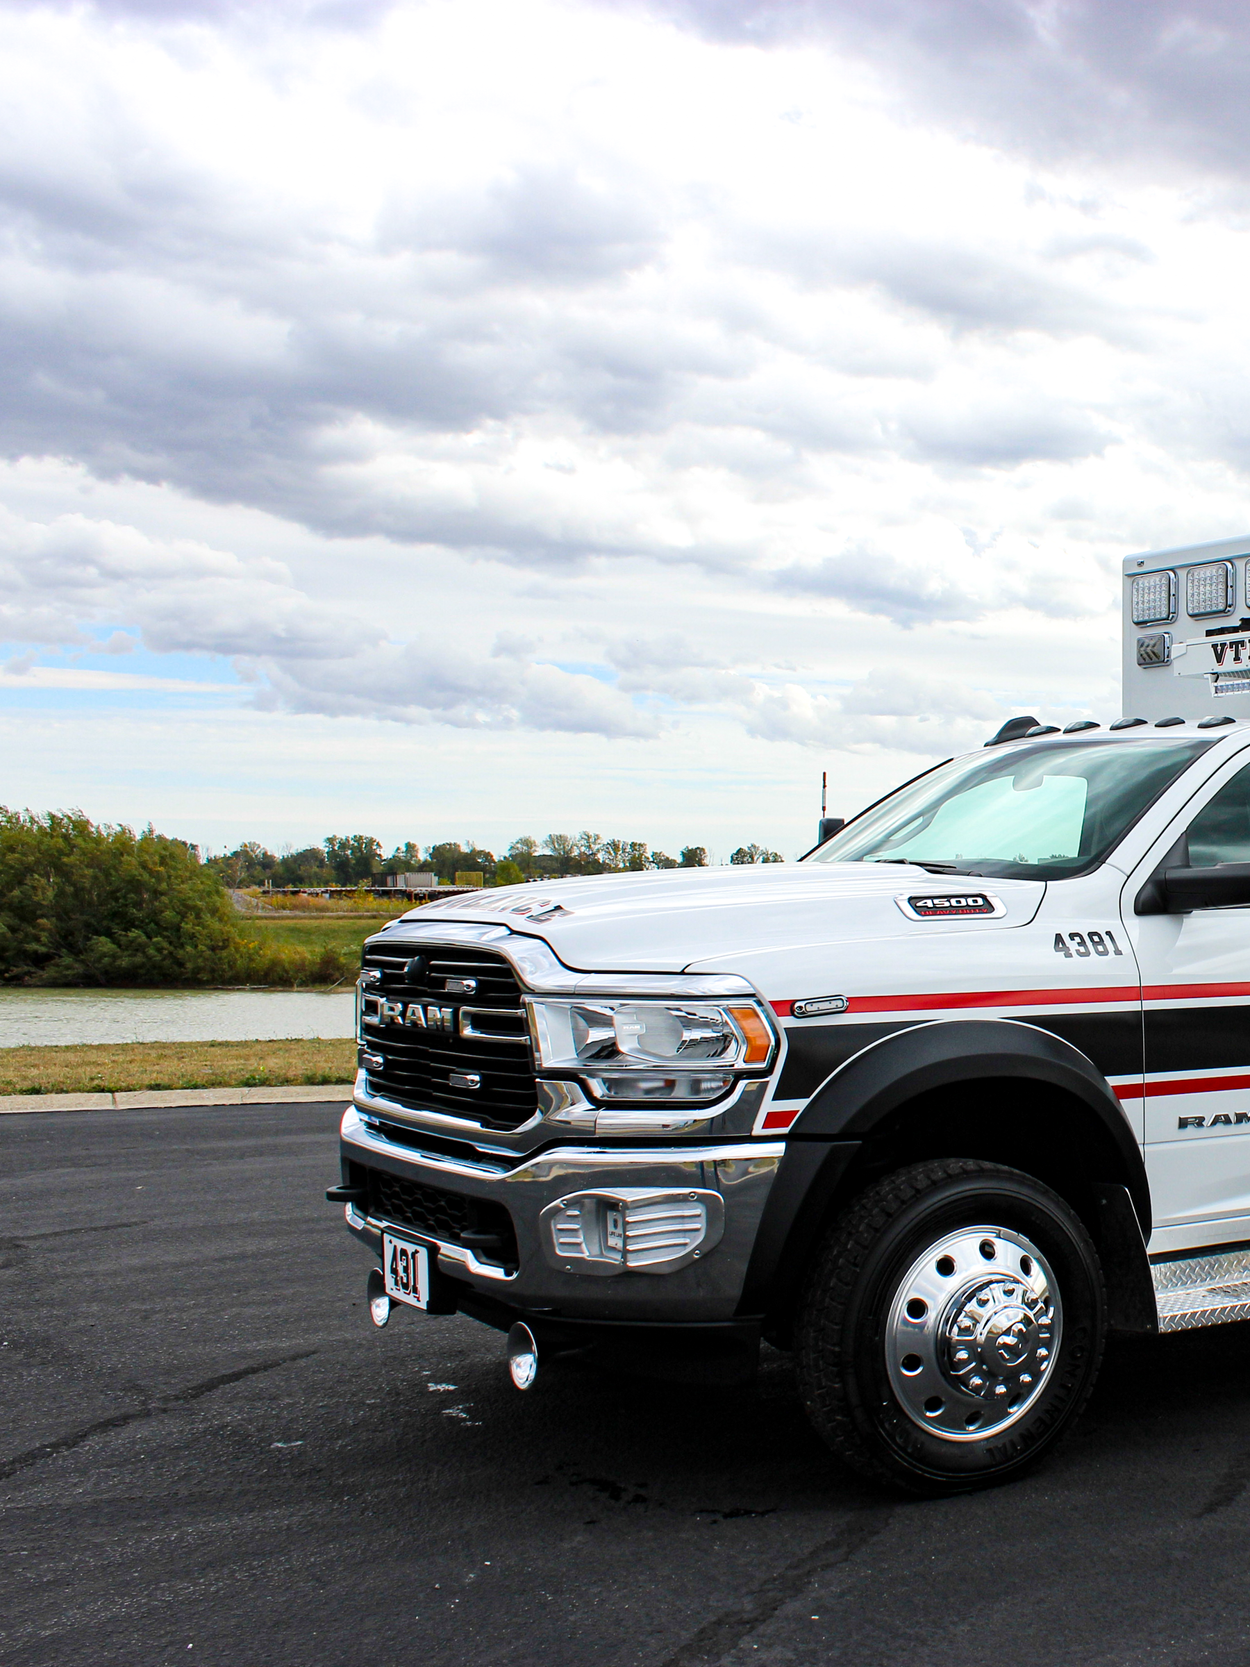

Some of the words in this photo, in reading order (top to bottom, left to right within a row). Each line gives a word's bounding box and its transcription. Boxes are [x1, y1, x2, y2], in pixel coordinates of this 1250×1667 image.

[915, 897, 984, 908] 4500
[1053, 930, 1123, 958] 4381
[382, 1002, 454, 1031] RAM
[390, 1244, 421, 1302] 431
[986, 1325, 1089, 1465] CONTINENTAL
